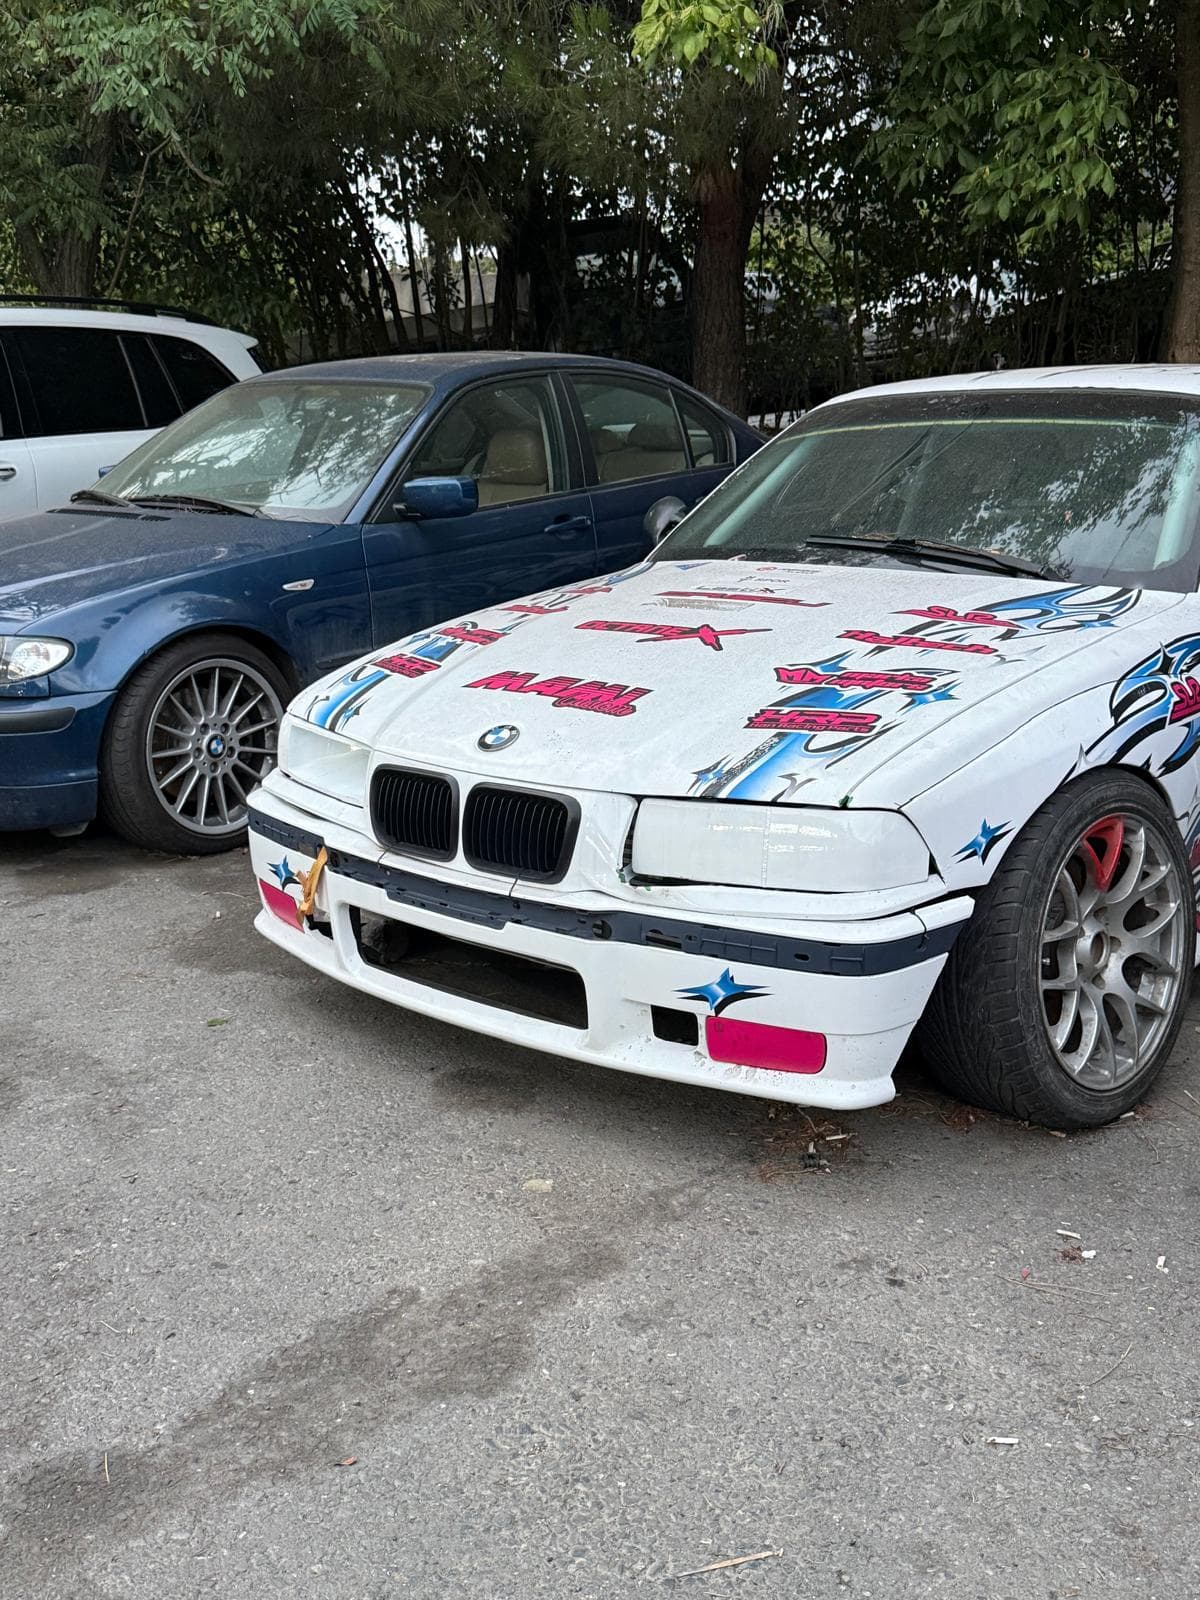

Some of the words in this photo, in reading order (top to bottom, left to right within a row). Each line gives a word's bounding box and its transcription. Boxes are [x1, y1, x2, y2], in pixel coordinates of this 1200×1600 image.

[836, 630, 999, 655] Haltech
[748, 709, 882, 726] HRP
[777, 722, 825, 732] Racing
[826, 723, 870, 733] Parts
